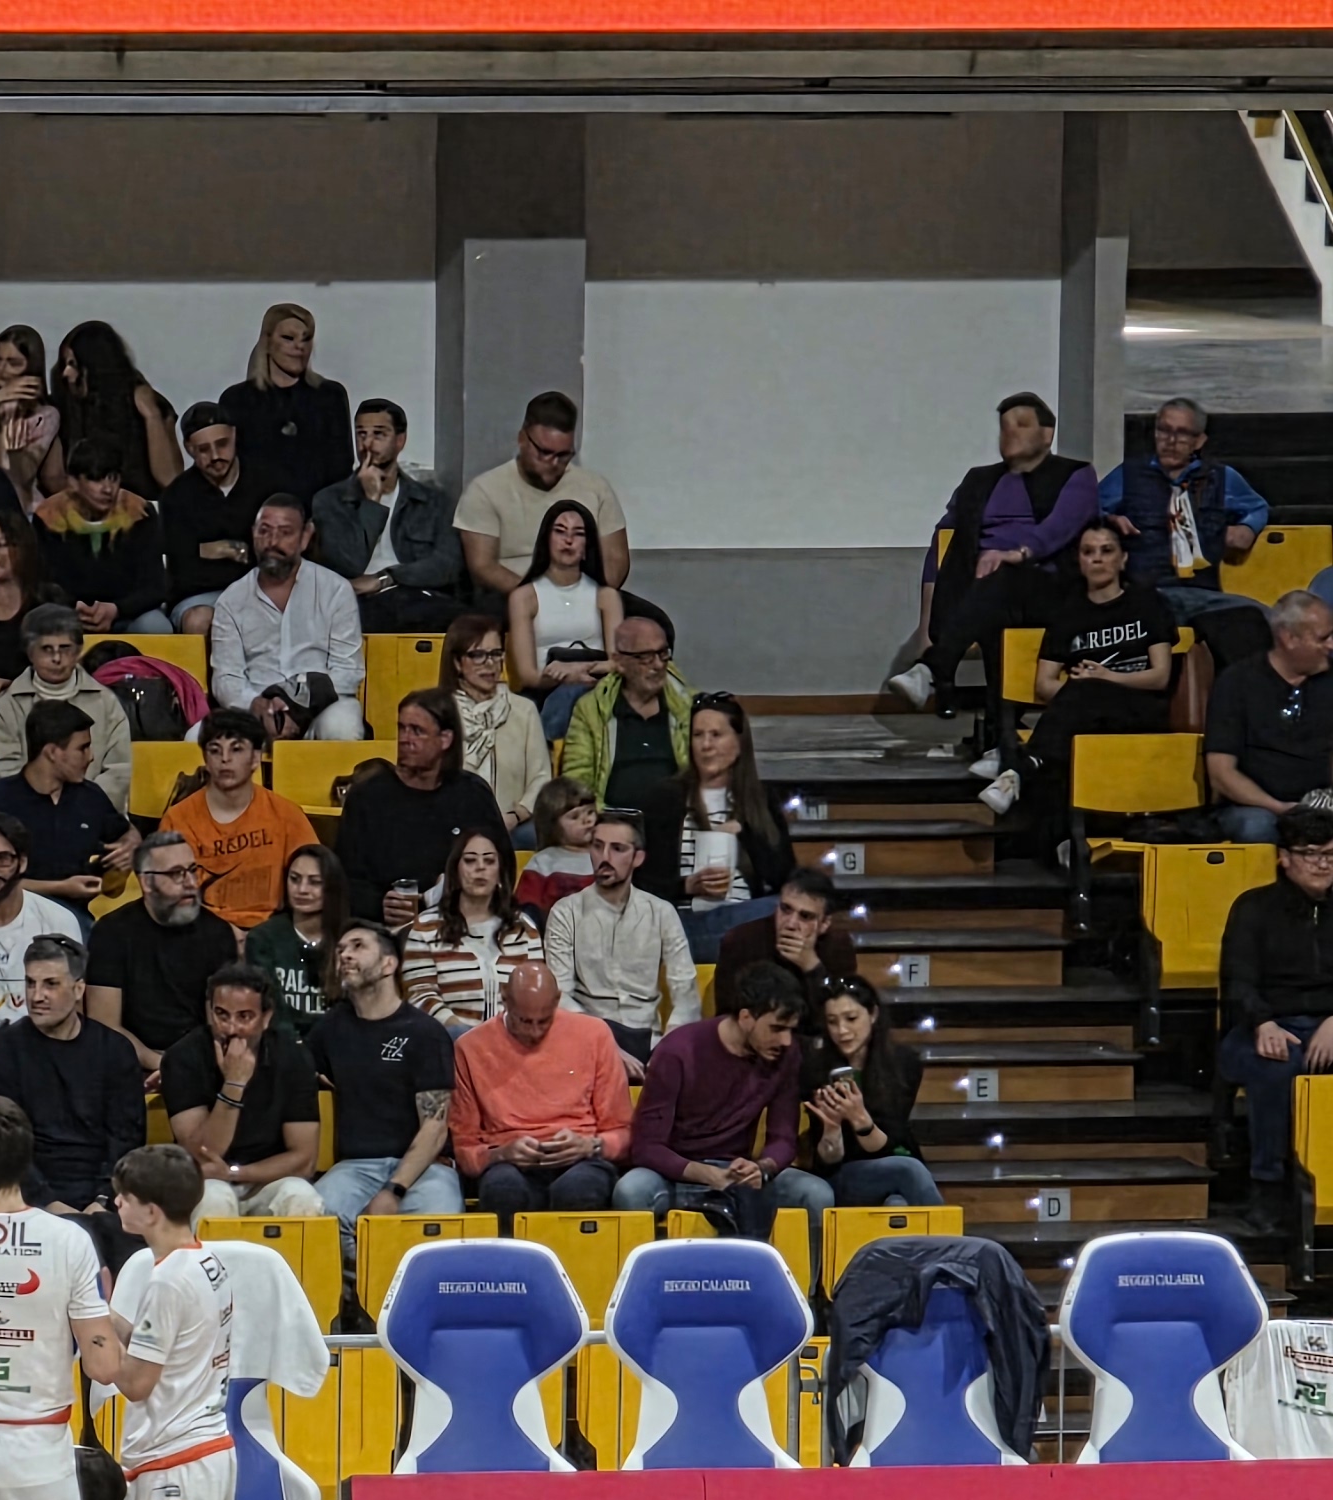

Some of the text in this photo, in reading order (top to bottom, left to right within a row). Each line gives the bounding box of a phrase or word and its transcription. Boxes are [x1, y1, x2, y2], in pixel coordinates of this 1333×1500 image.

[842, 852, 857, 871] G
[908, 962, 919, 983] F
[976, 1077, 989, 1098] E
[1047, 1197, 1062, 1217] D
[438, 1281, 528, 1294] REGGIO CALABRIA
